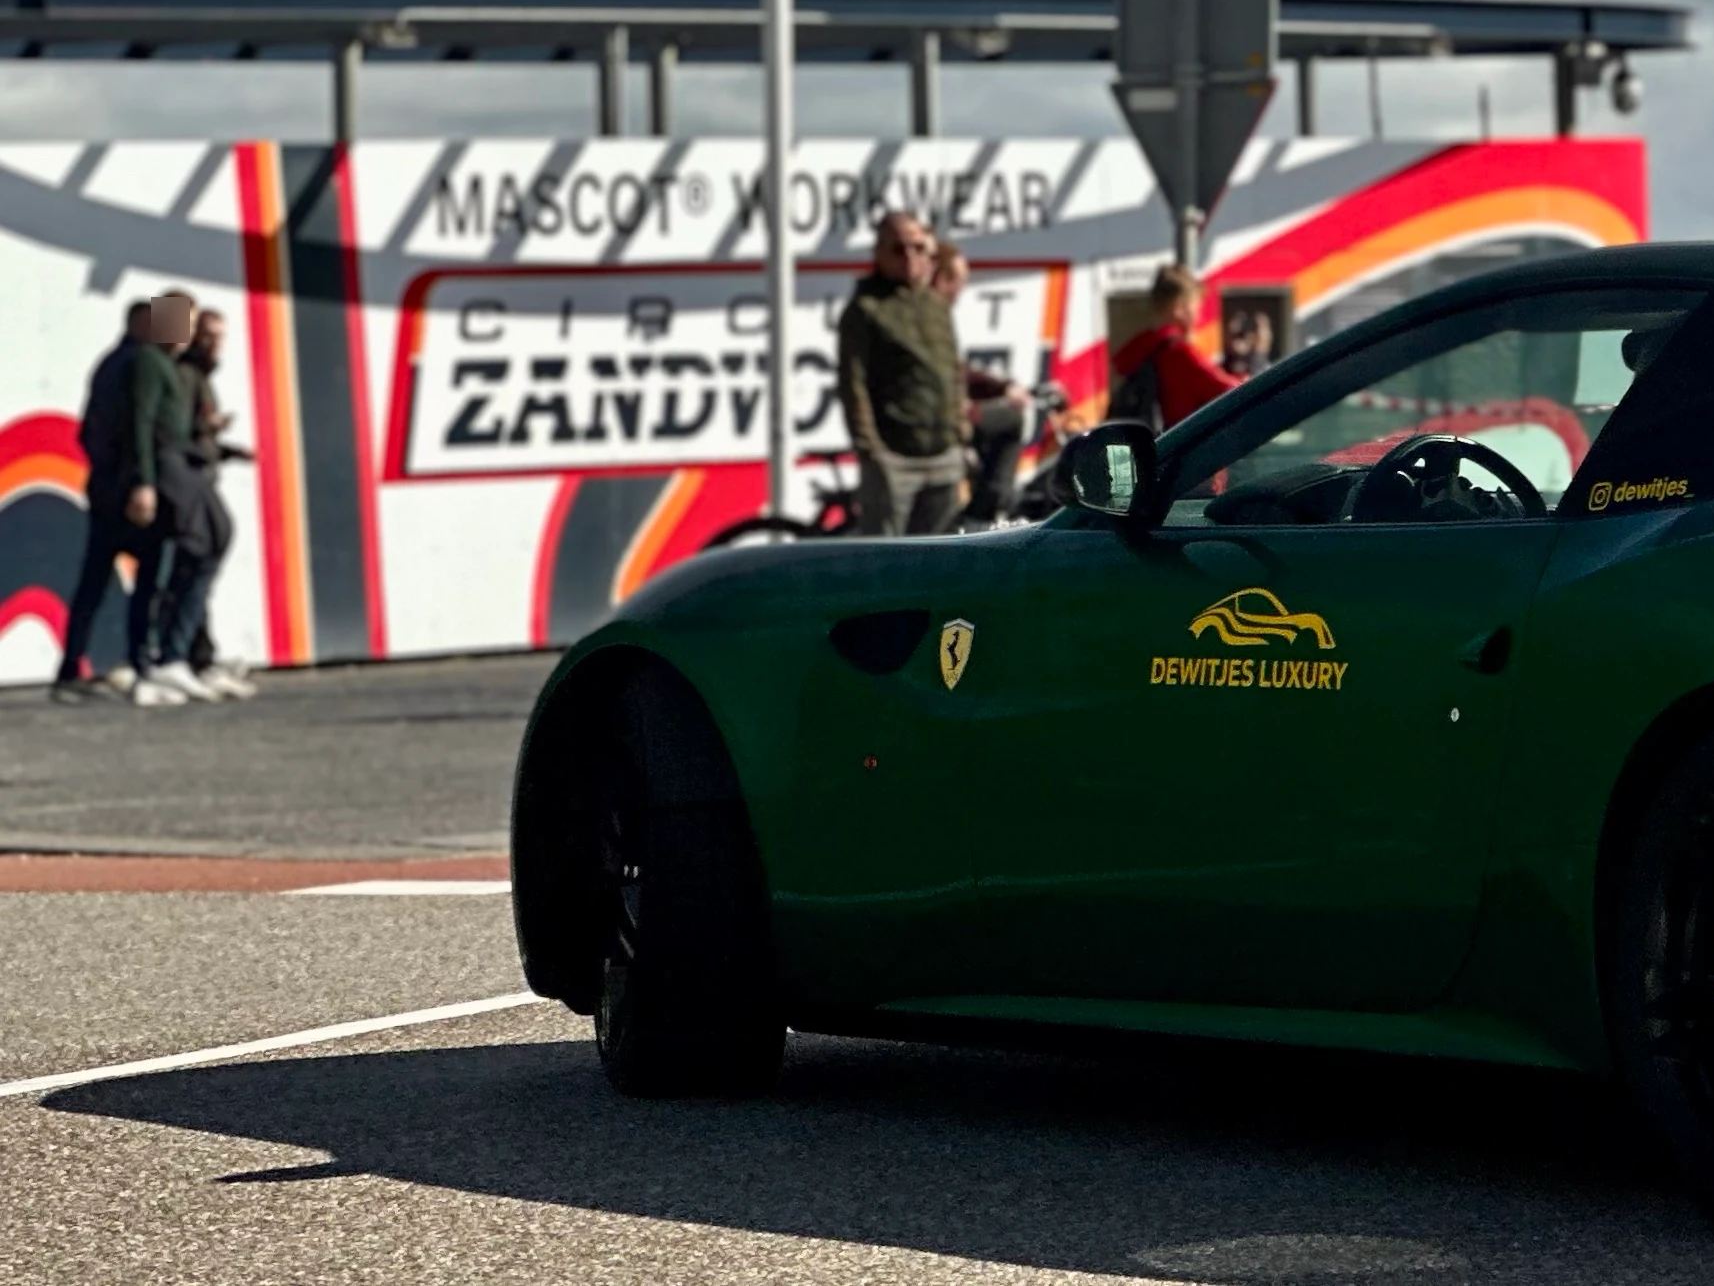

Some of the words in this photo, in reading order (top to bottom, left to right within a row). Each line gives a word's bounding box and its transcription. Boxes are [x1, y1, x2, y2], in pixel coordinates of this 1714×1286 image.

[732, 170, 1050, 235] WORKWEAR
[458, 291, 1018, 345] CIRCT
[1150, 657, 1255, 688] DEWITJES
[1258, 660, 1349, 690] LUXURY
